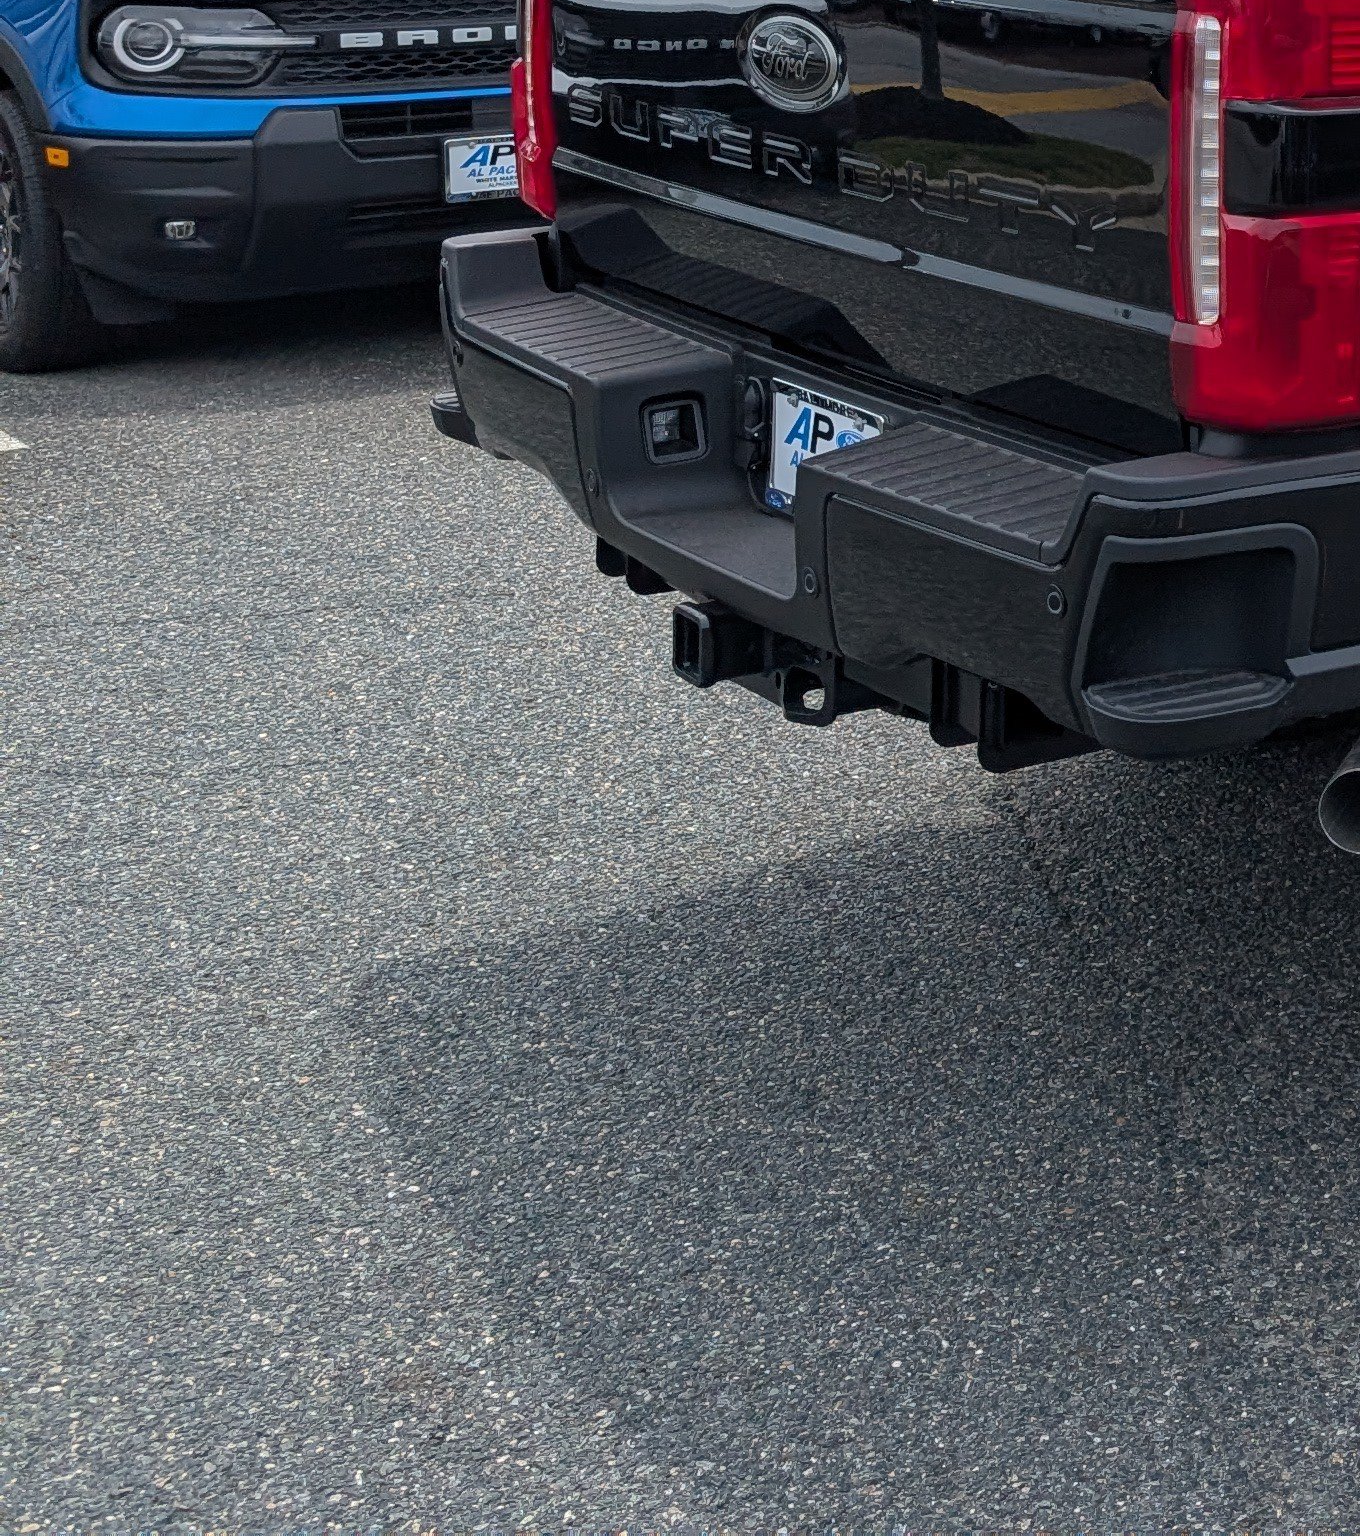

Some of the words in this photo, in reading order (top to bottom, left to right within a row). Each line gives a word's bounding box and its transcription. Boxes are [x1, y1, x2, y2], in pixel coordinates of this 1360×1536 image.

[340, 25, 517, 48] BRO
[760, 32, 815, 81] Ford
[568, 83, 812, 185] SUPER
[466, 168, 484, 178] AL
[489, 165, 517, 176] PAC
[838, 147, 1117, 252] DUTY
